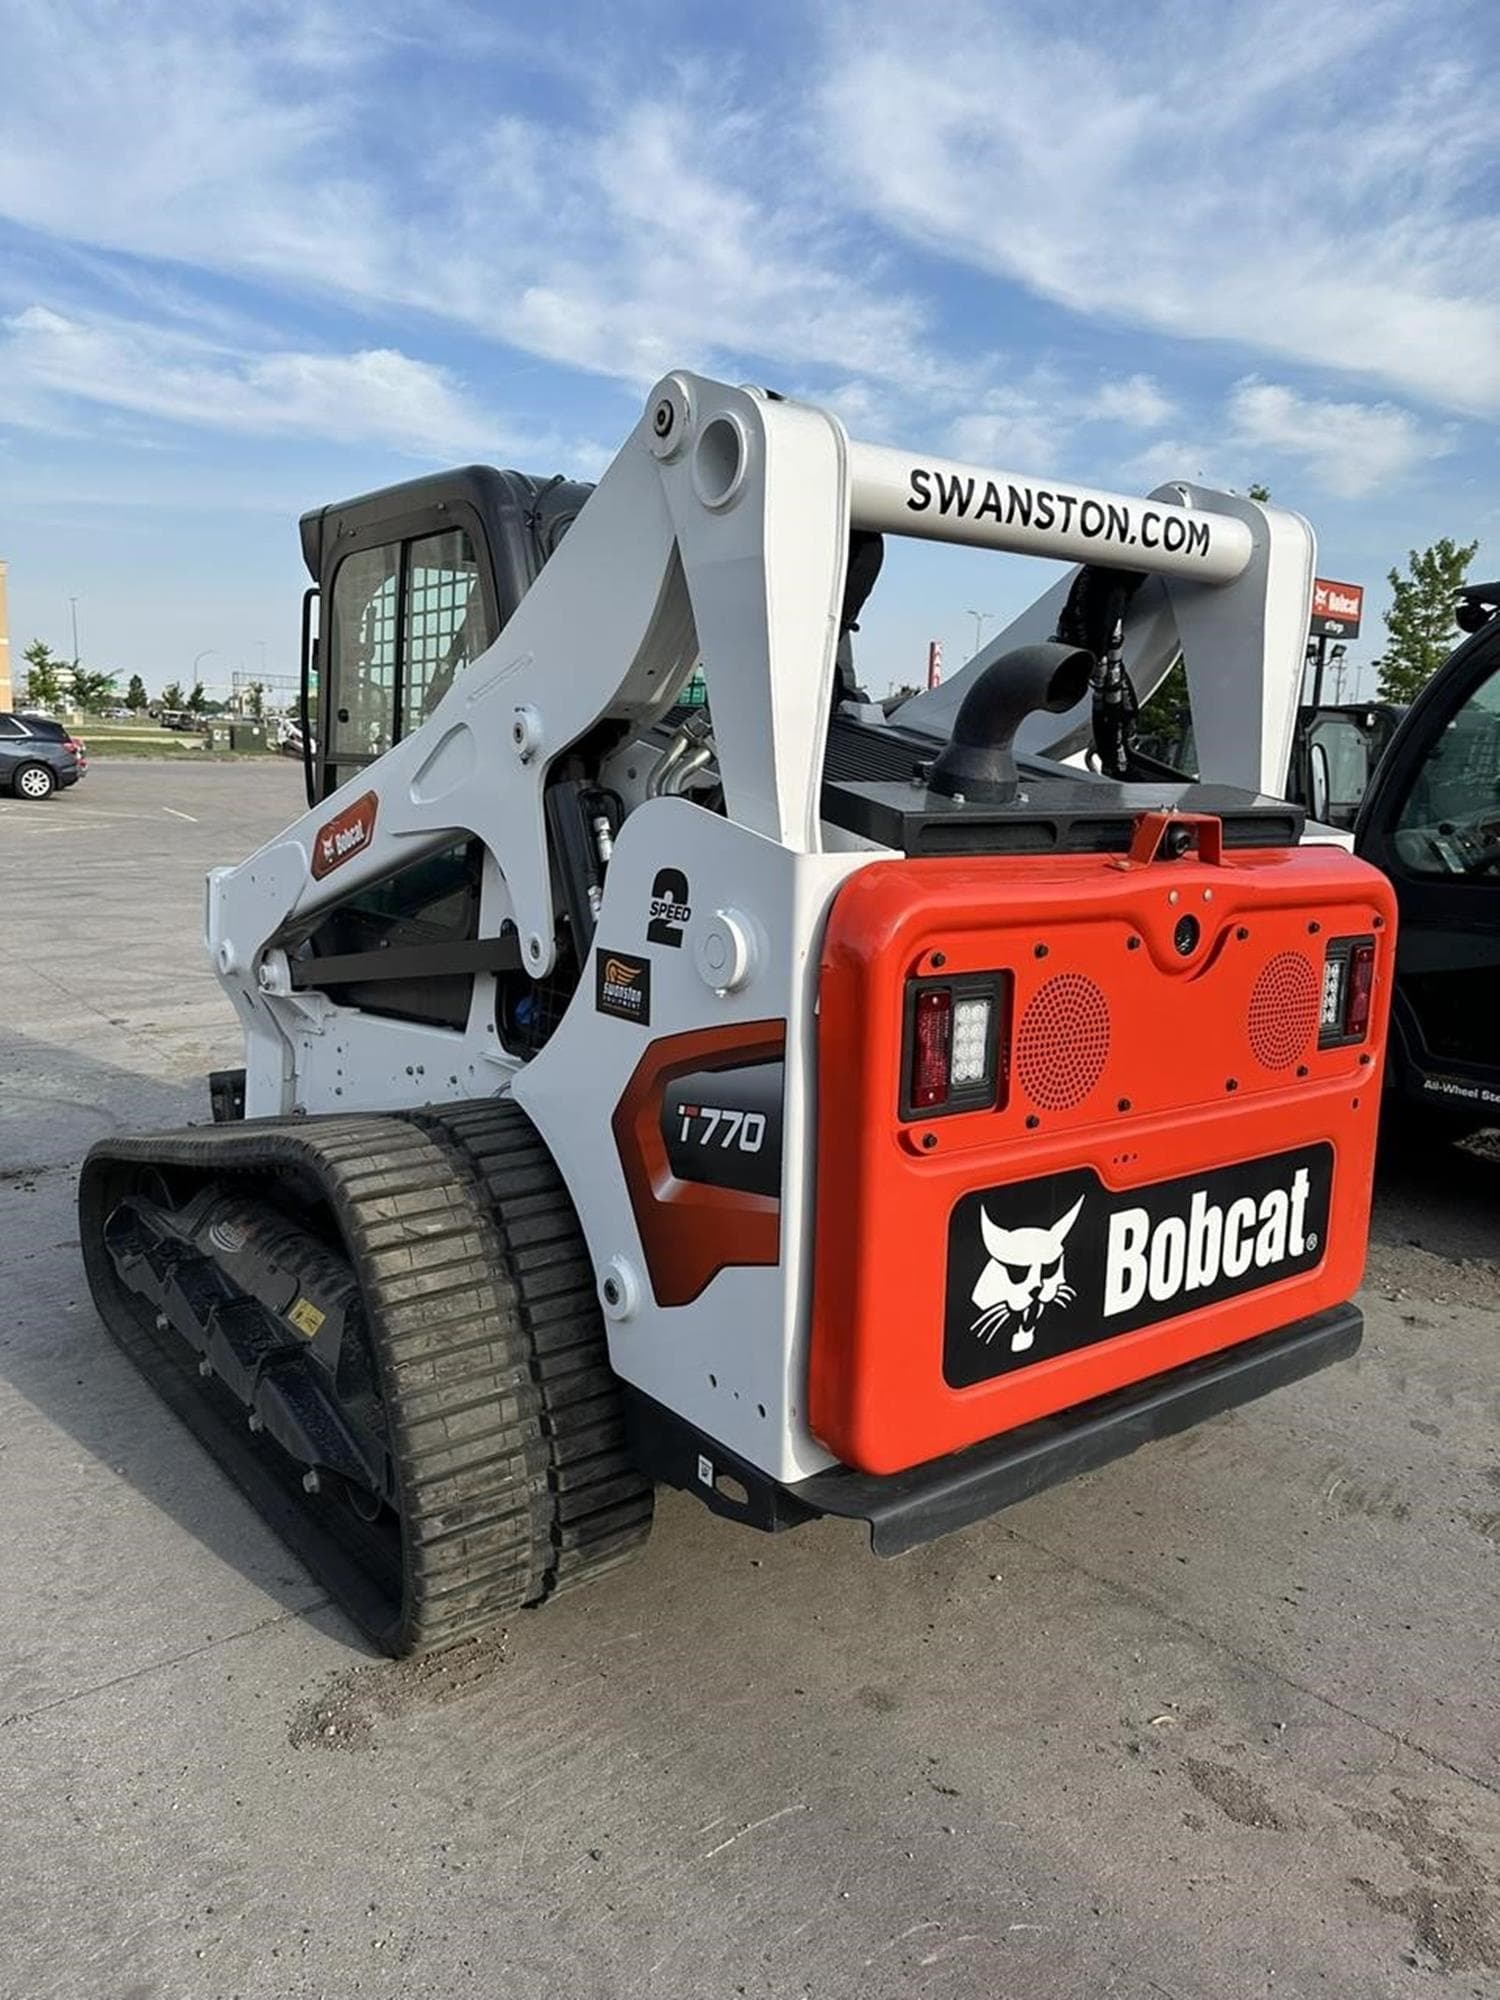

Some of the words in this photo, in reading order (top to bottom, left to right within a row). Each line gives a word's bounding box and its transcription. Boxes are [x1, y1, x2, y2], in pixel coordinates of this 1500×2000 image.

[906, 468, 1210, 557] SWANSTON.COM
[649, 900, 692, 922] SPEED
[1423, 1079, 1479, 1099] All-Wheel
[676, 1103, 767, 1153] T770
[1103, 1167, 1311, 1318] Bobcat
